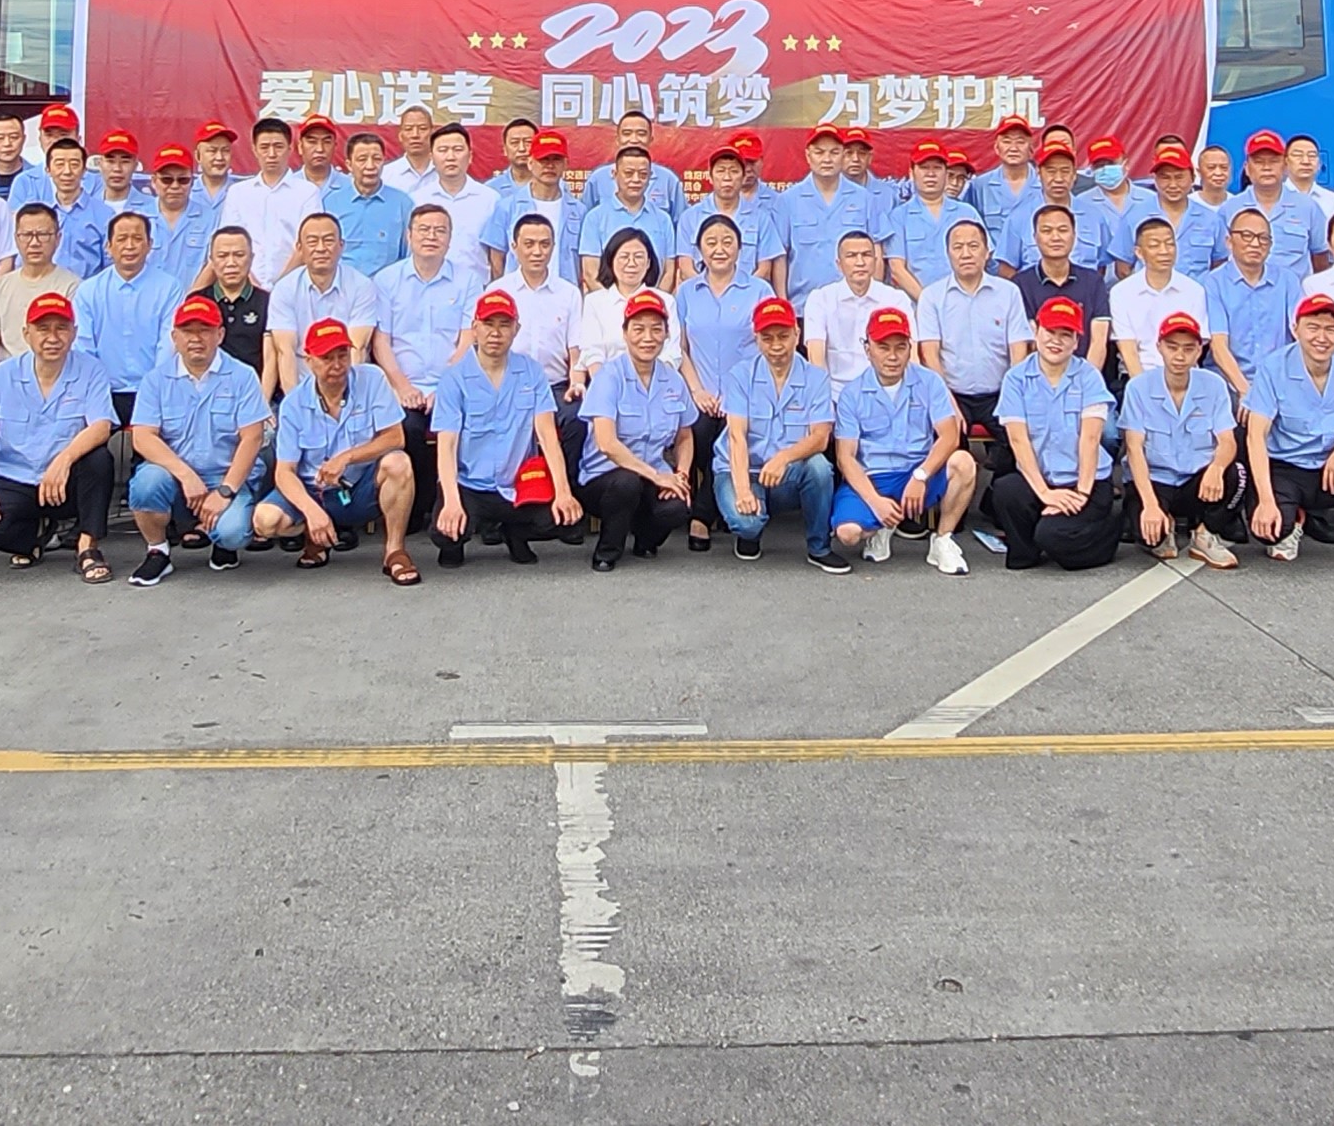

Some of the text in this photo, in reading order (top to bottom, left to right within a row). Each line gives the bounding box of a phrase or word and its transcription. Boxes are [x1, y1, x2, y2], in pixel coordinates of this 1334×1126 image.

[259, 70, 1046, 129] 爱心送考 同心筑梦 为梦护航
